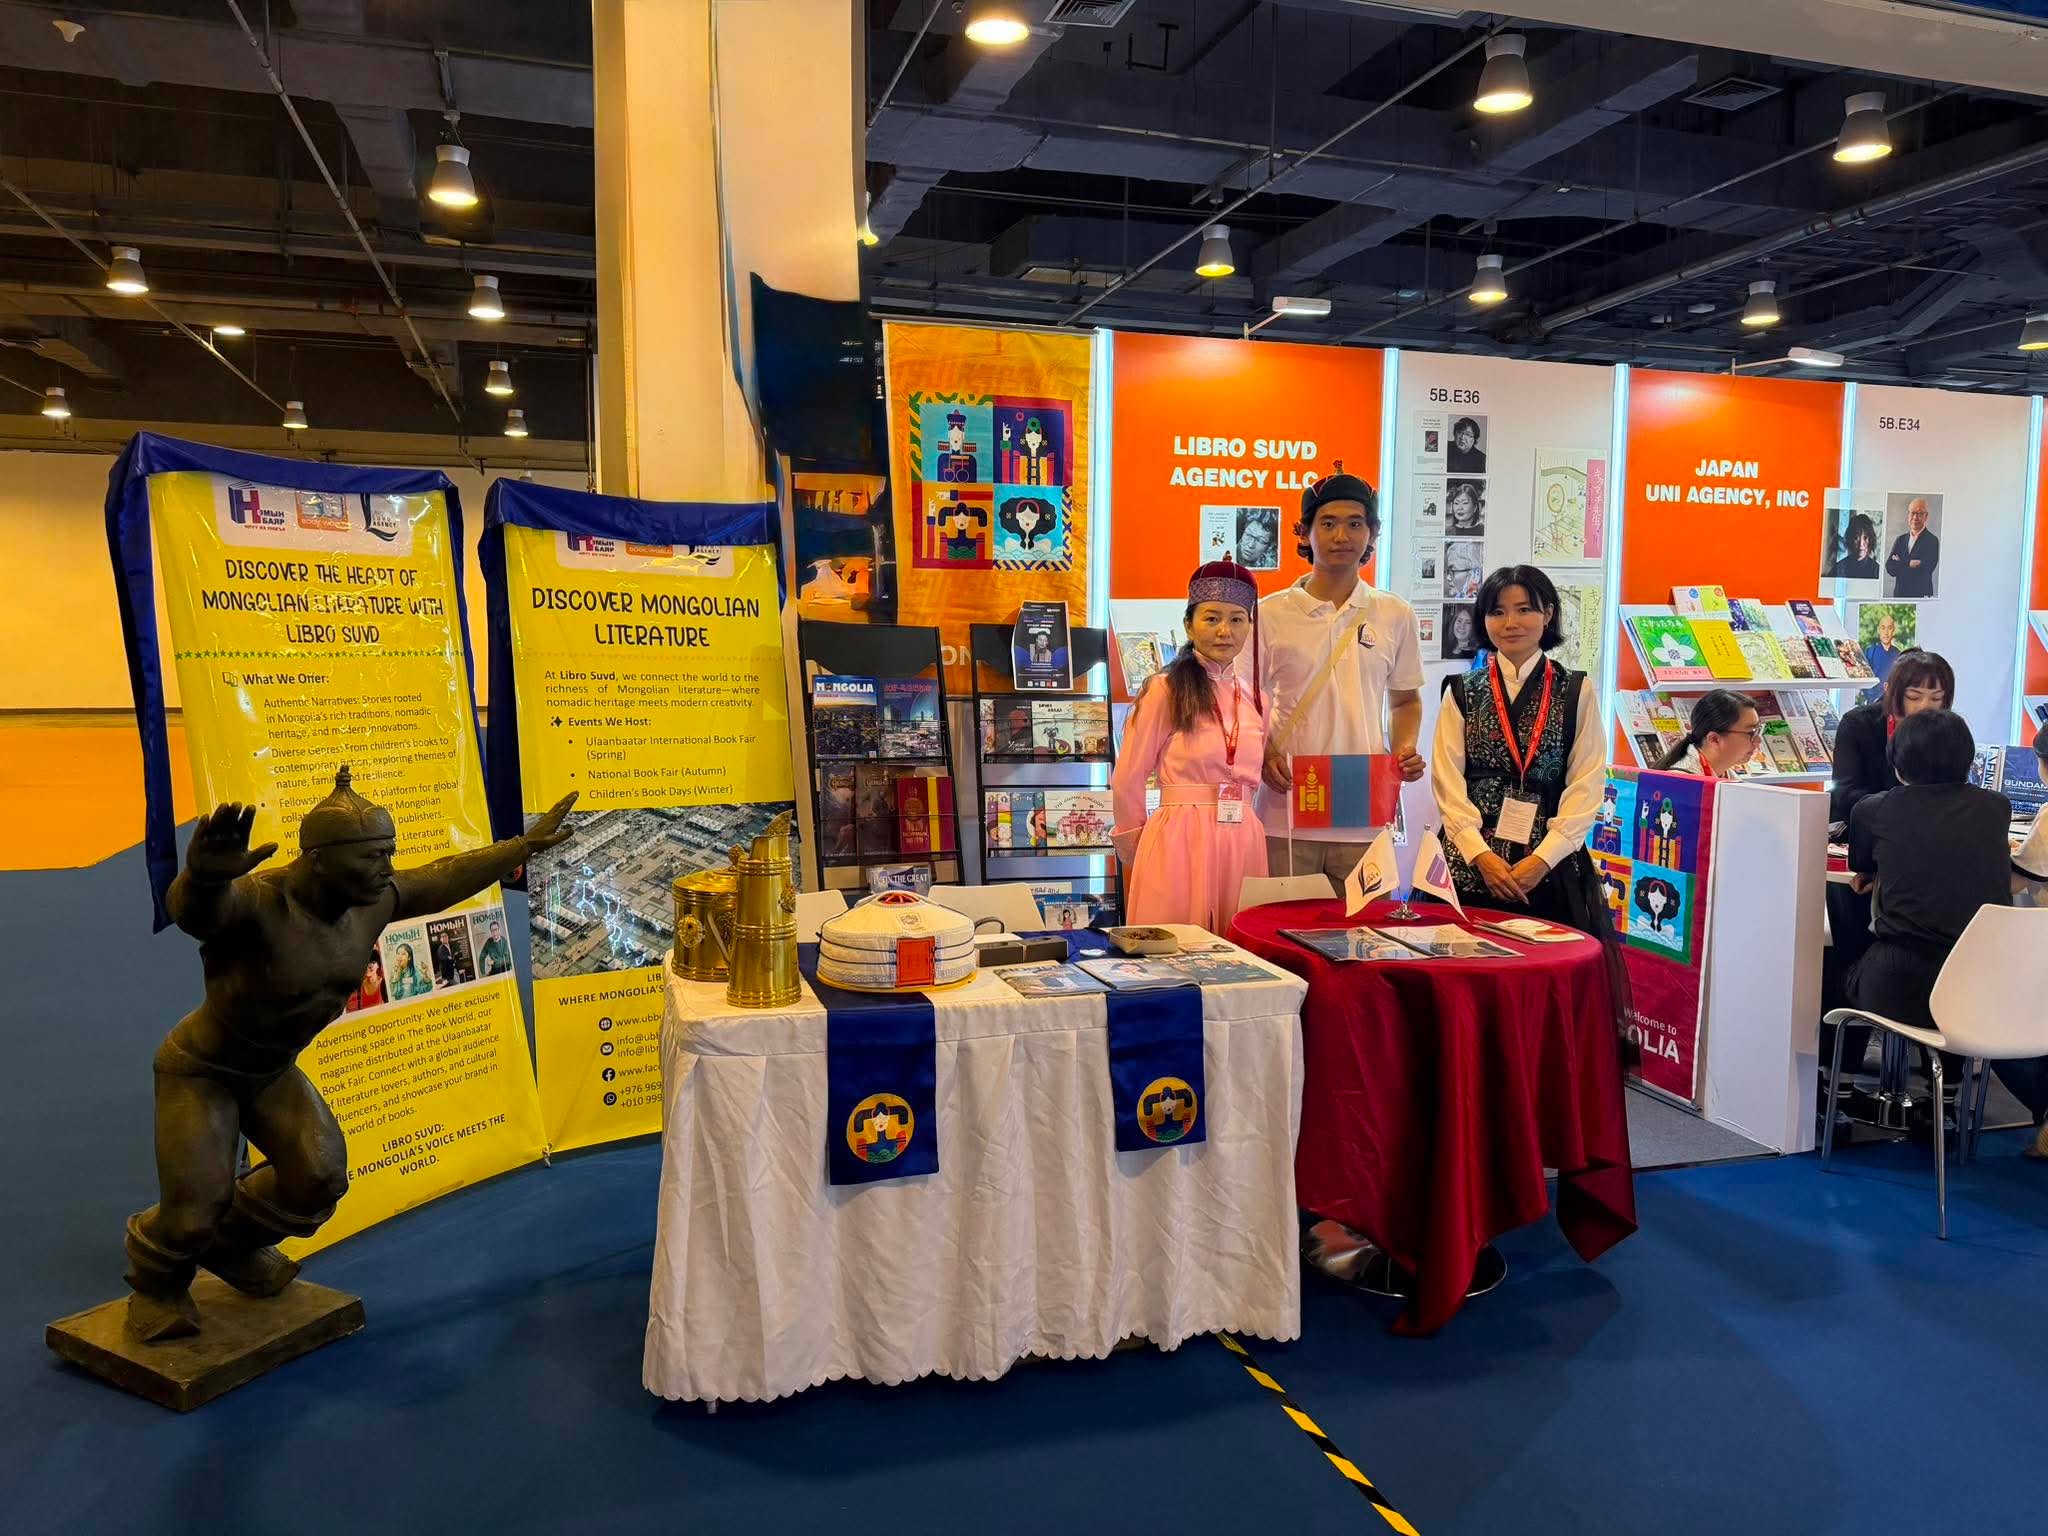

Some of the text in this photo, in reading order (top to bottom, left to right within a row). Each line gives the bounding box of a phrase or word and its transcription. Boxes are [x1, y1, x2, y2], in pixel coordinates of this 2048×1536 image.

[1430, 388, 1479, 403] 5B.E36
[1880, 417, 1920, 430] 5B.E34
[1174, 436, 1317, 460] LIBRO SUVD
[1696, 459, 1758, 478] JAPAN
[1170, 467, 1318, 489] AGENCY LLC
[1646, 484, 1809, 508] UNI AGENCY, INC
[225, 559, 418, 586] DISCOVER THE HEART OF
[202, 590, 309, 612] MONGOLIAN
[409, 598, 444, 615] WITH
[531, 587, 760, 618] DISCOVER MONGOLIAN
[286, 624, 379, 643] LIBRO SUVD
[595, 624, 710, 647] LITERATURE
[243, 674, 273, 685] What
[276, 674, 295, 684] We
[544, 670, 555, 680] At
[560, 671, 587, 680] Libro
[590, 672, 619, 682] Suvd,
[640, 673, 678, 681] connect
[682, 673, 698, 681] the
[702, 673, 728, 682] world
[731, 674, 741, 682] to
[744, 674, 759, 682] the
[545, 684, 669, 696] richness of Mongolian
[264, 693, 422, 708] Authentic Narratives: Stories rooted
[546, 698, 753, 709] nomadic heritage meets modern creativity.
[330, 711, 346, 719] rich
[349, 710, 392, 721] traditions,
[395, 708, 431, 716] nomadic
[568, 717, 651, 726] Events We Host:
[312, 728, 329, 736] and
[332, 726, 366, 735] modern
[272, 748, 306, 758] Diverse
[371, 740, 411, 750] children's
[413, 738, 437, 748] books
[440, 737, 448, 745] to
[586, 735, 756, 746] Ulaanbaatar International Book Fair
[373, 755, 413, 766] exploring
[415, 752, 446, 761] themes
[448, 750, 456, 758] of
[587, 750, 626, 760] (Spring)
[588, 766, 726, 779] National Book Fair (Autumn)
[277, 779, 309, 789] nature,
[381, 786, 417, 798] platform
[419, 784, 431, 793] for
[434, 780, 459, 792] global
[589, 784, 733, 799] Children's Book Days (Winter)
[396, 797, 441, 810] Mongolian
[399, 813, 445, 824] publishers.
[402, 828, 444, 840] Literature
[434, 842, 450, 850] and
[908, 874, 927, 882] GREAT
[429, 919, 465, 934] НОМЫН
[385, 929, 420, 944] НОМЫН
[647, 974, 662, 982] LIB
[559, 984, 664, 1006] WHERE MONGOLIA'S
[316, 992, 500, 1050] Advertising Opportunity: We offer exclusive
[1624, 1007, 1677, 1035] Welcome to
[318, 1009, 492, 1066] advertising space in The Book World, our
[320, 1023, 492, 1081] magazine distributed at the Ulaanbaatar
[322, 1034, 499, 1096] Book Fair. Connect with global audience
[337, 1049, 497, 1107] literature lovers, authors, and cultural
[383, 1063, 498, 1108] and showcase your brand in
[619, 1084, 642, 1096] +976
[620, 1096, 643, 1108] +010
[348, 1106, 417, 1135] world of books.
[357, 1143, 424, 1178] MONGOLIA'S
[425, 1133, 454, 1152] VOICE
[457, 1120, 487, 1140] MEETS
[490, 1113, 506, 1127] THE
[382, 1124, 445, 1152] LIBRO SUVD:
[400, 1154, 440, 1176] WORLD.
